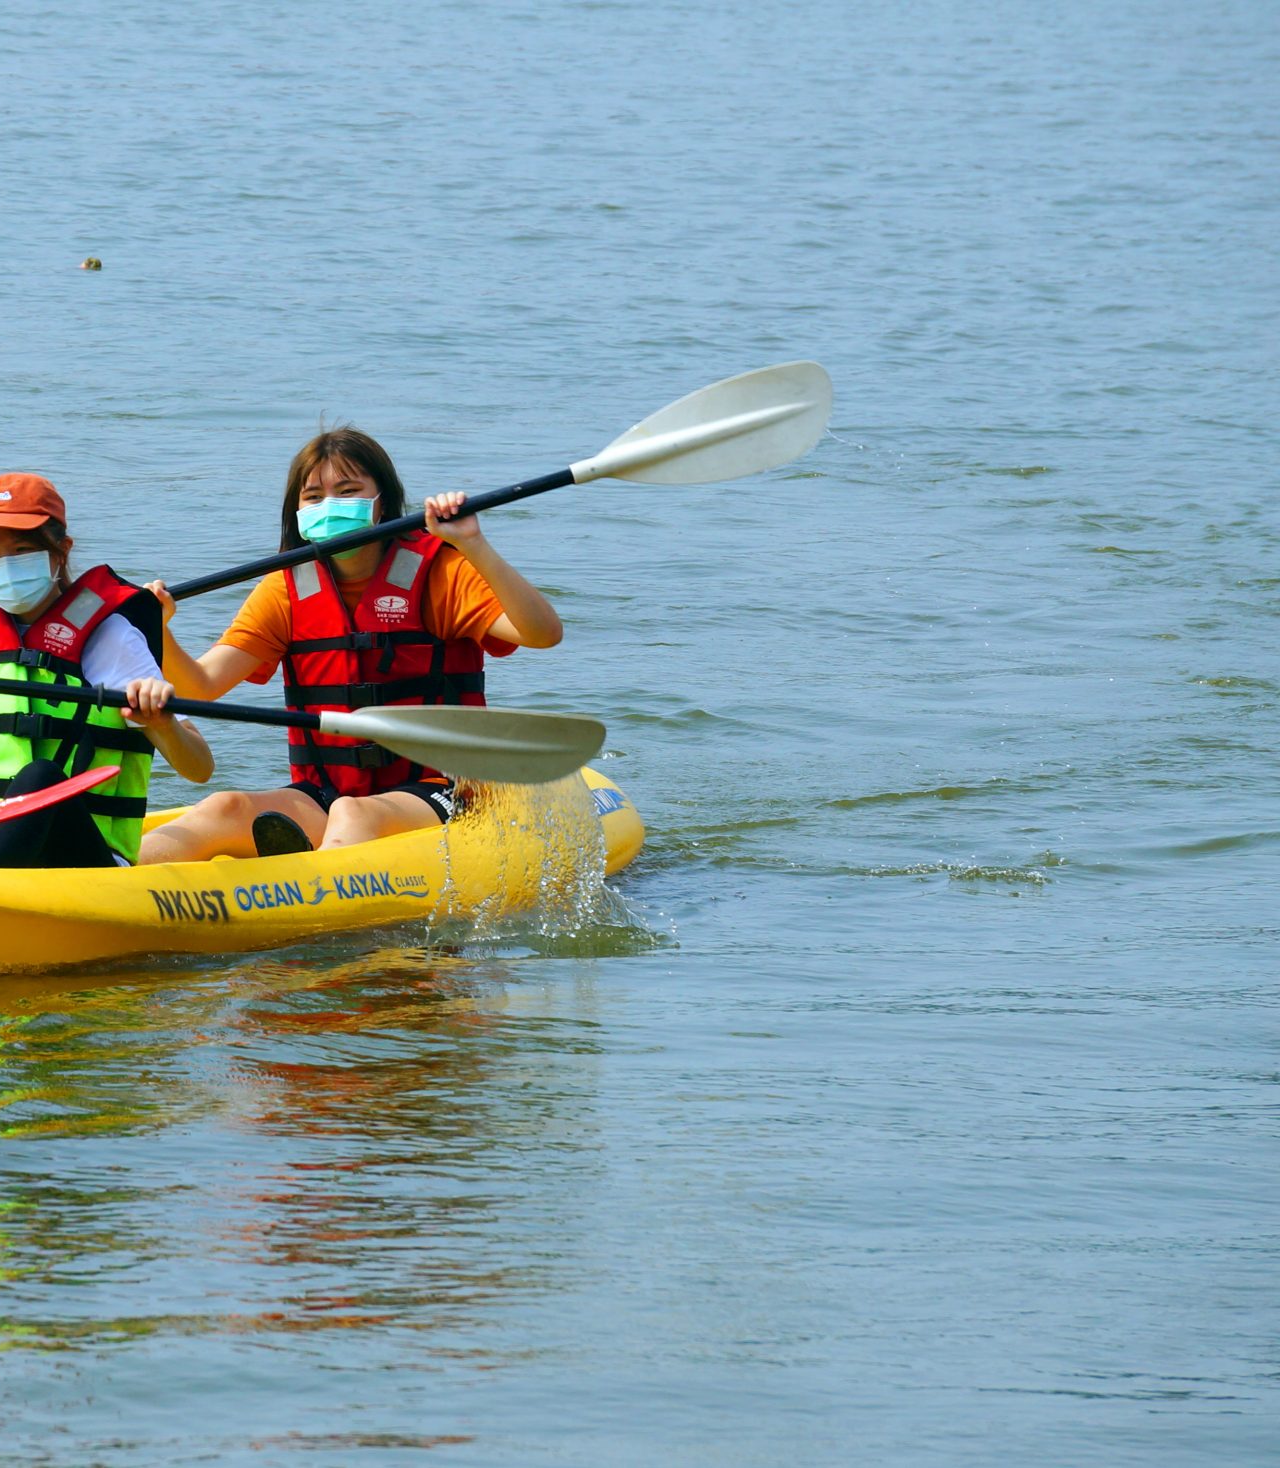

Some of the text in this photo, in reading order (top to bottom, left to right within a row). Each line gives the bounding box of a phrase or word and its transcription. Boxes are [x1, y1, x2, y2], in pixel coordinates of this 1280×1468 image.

[148, 889, 231, 922] NKUST
[234, 871, 428, 912] OCEAN KAYAK CLASSIC
